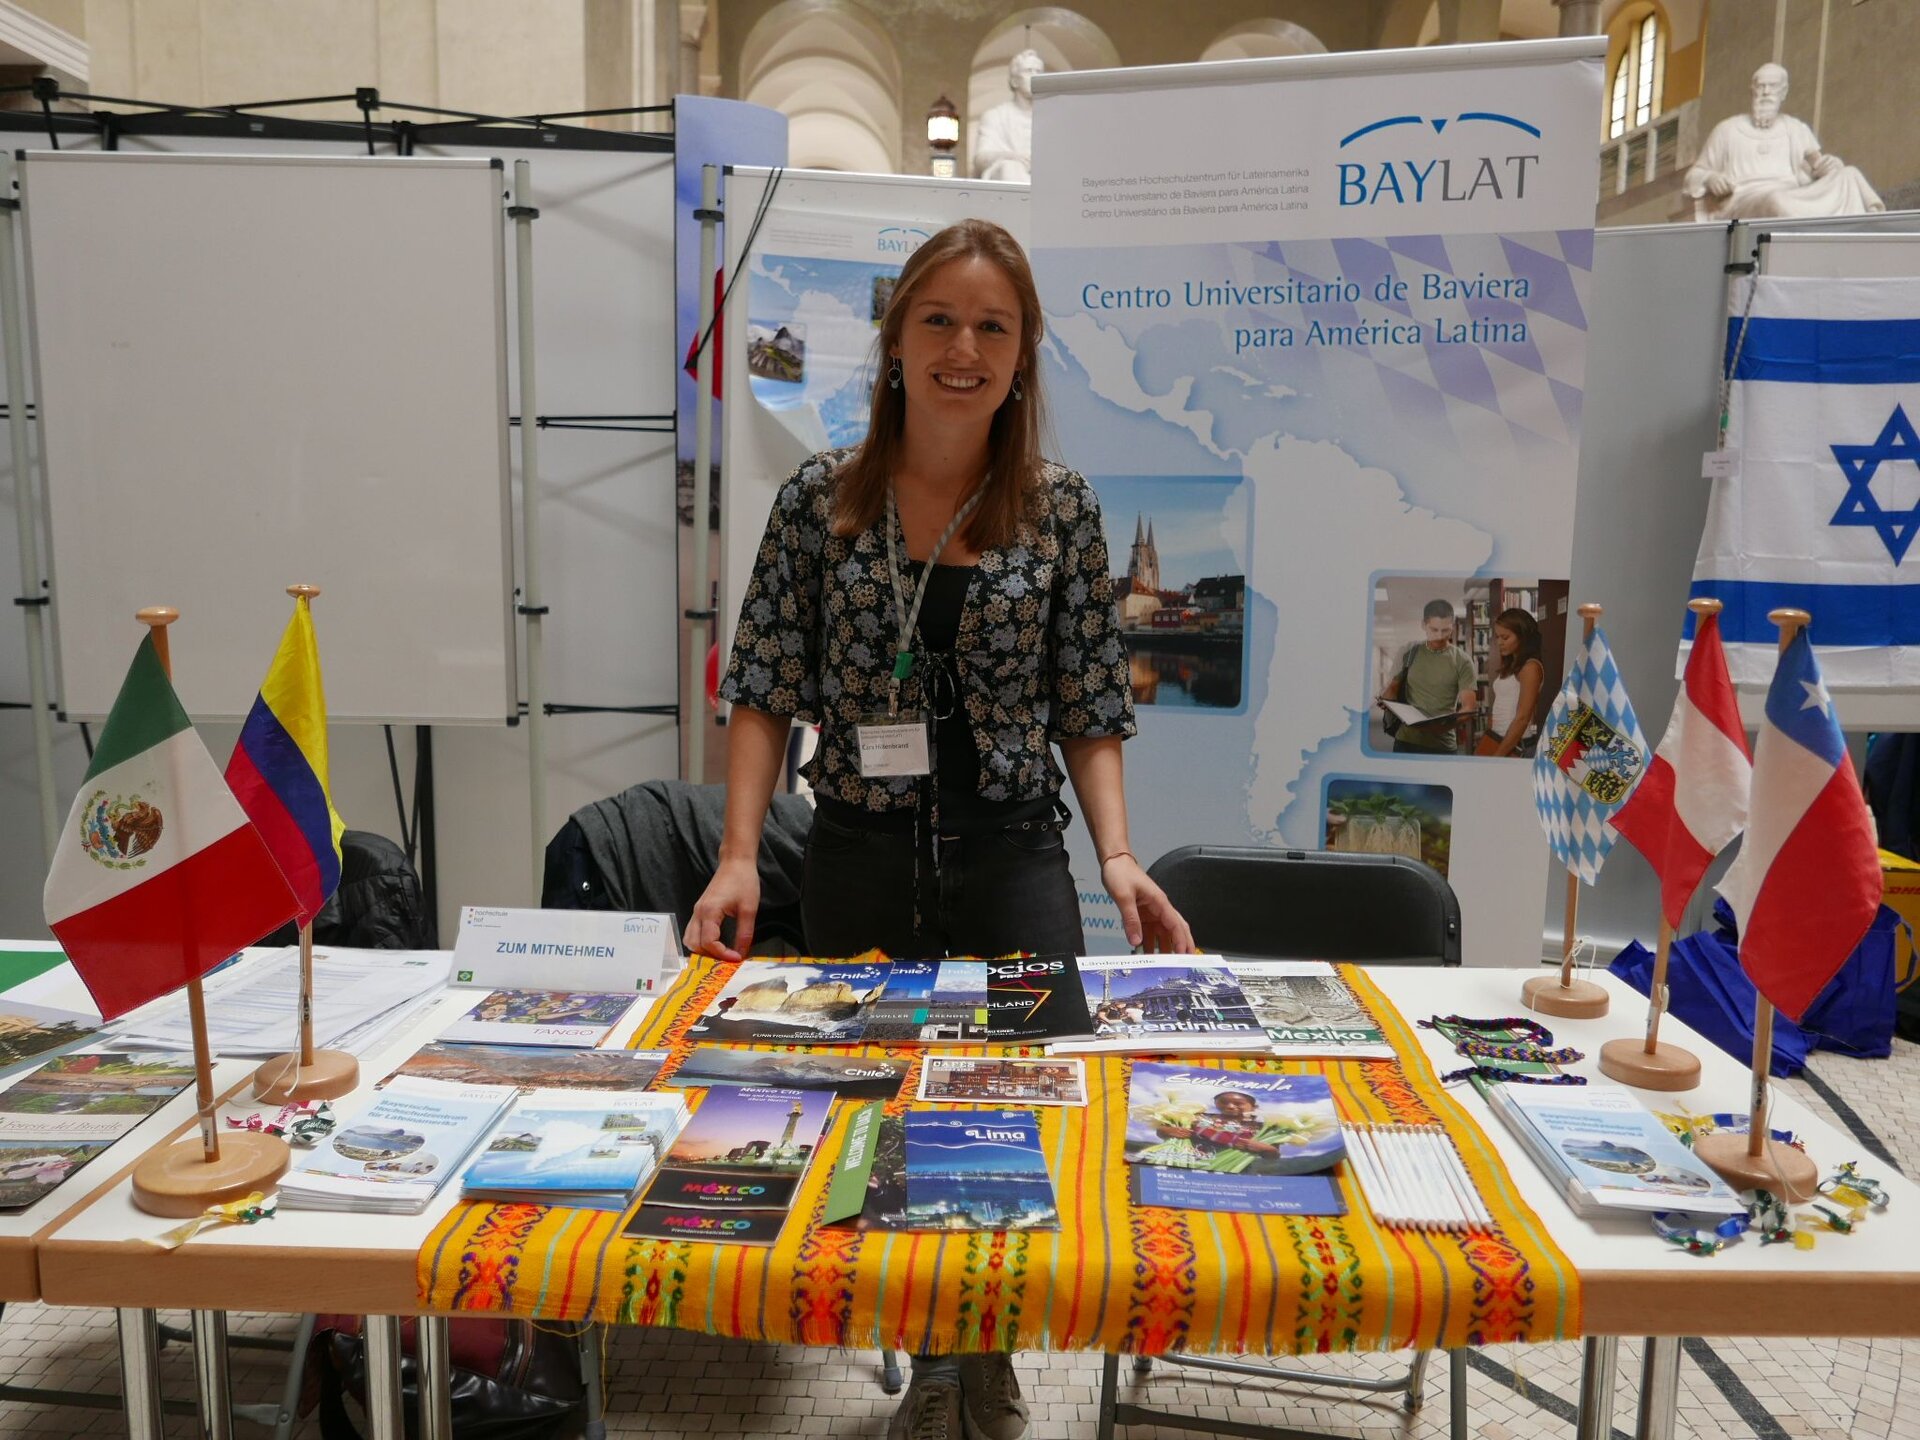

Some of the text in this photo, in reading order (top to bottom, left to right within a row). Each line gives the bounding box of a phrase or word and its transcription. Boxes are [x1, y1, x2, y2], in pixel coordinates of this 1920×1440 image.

[1082, 177, 1137, 188] Bayerisches
[1139, 173, 1226, 185] Hochschulzentrum
[1242, 168, 1309, 180] Lateinamerika
[1336, 155, 1539, 206] BAYLAT
[1082, 193, 1112, 203] Centro
[1169, 190, 1182, 200] de
[1183, 189, 1216, 199] Baviera
[1218, 188, 1239, 199] para
[1240, 185, 1279, 196] América
[1280, 184, 1308, 194] Latina
[1082, 209, 1112, 219] Centro
[1183, 205, 1216, 215] Baviera
[1218, 204, 1239, 215] para
[1240, 201, 1279, 212] América
[1280, 200, 1308, 211] Latina
[877, 239, 921, 253] BAYLA
[1082, 272, 1530, 311] Centro Universitario de Baviera
[1234, 316, 1527, 355] para América Latina
[624, 924, 659, 934] BAYLAT
[496, 942, 615, 958] ZUM MITNEHMEN
[829, 972, 871, 980] Chile
[533, 1028, 594, 1036] TANGO
[1096, 1021, 1250, 1035] Argentinien
[1267, 1028, 1367, 1040] Mexiko
[845, 1068, 884, 1077] Chile
[1165, 1073, 1292, 1091] Guatemala
[965, 1129, 1025, 1139] Lima
